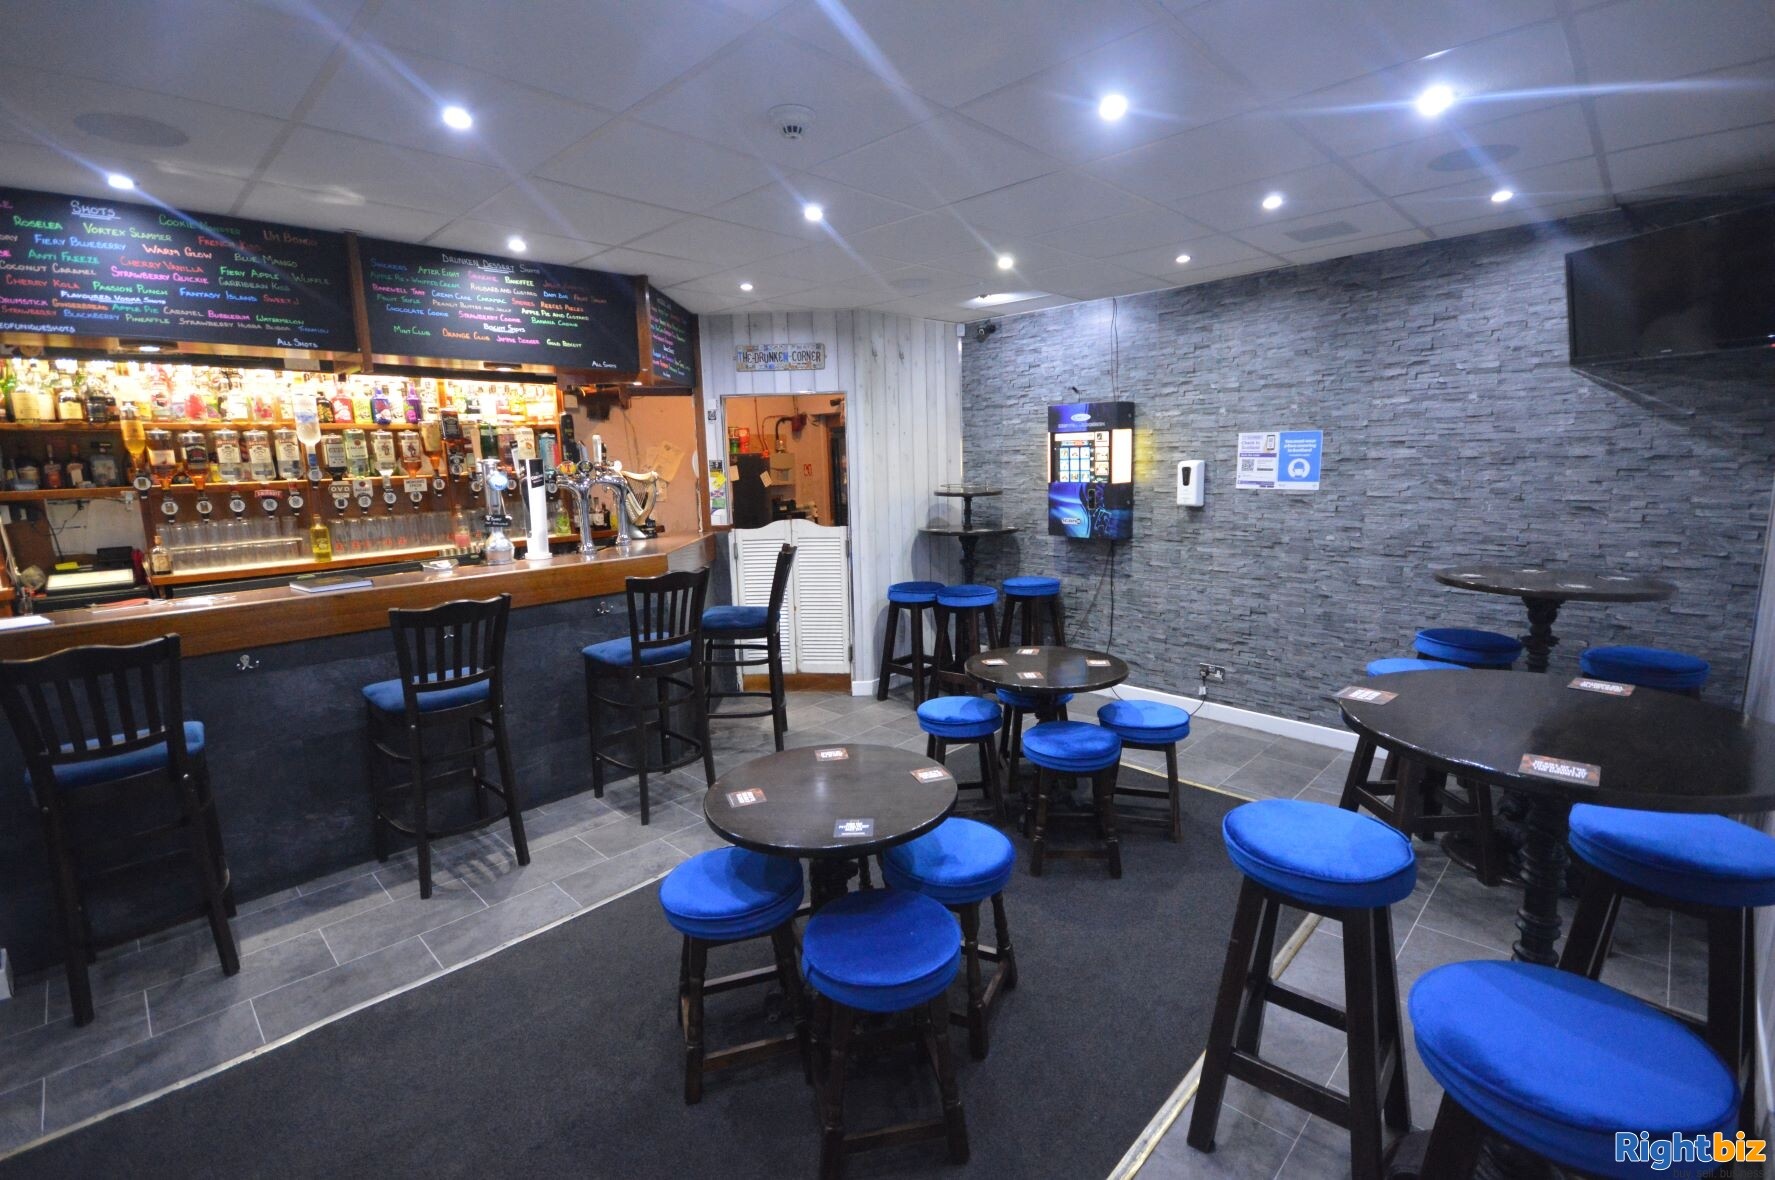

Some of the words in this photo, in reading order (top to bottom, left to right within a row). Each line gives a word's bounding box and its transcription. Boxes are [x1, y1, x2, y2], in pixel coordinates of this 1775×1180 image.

[70, 200, 116, 216] SHOTS
[82, 222, 126, 236] VORTEX
[128, 227, 172, 242] SLAMMER
[142, 244, 180, 256] WARM
[184, 247, 212, 259] GLOW
[0, 260, 48, 272] COCONUT
[791, 350, 821, 363] CORNER
